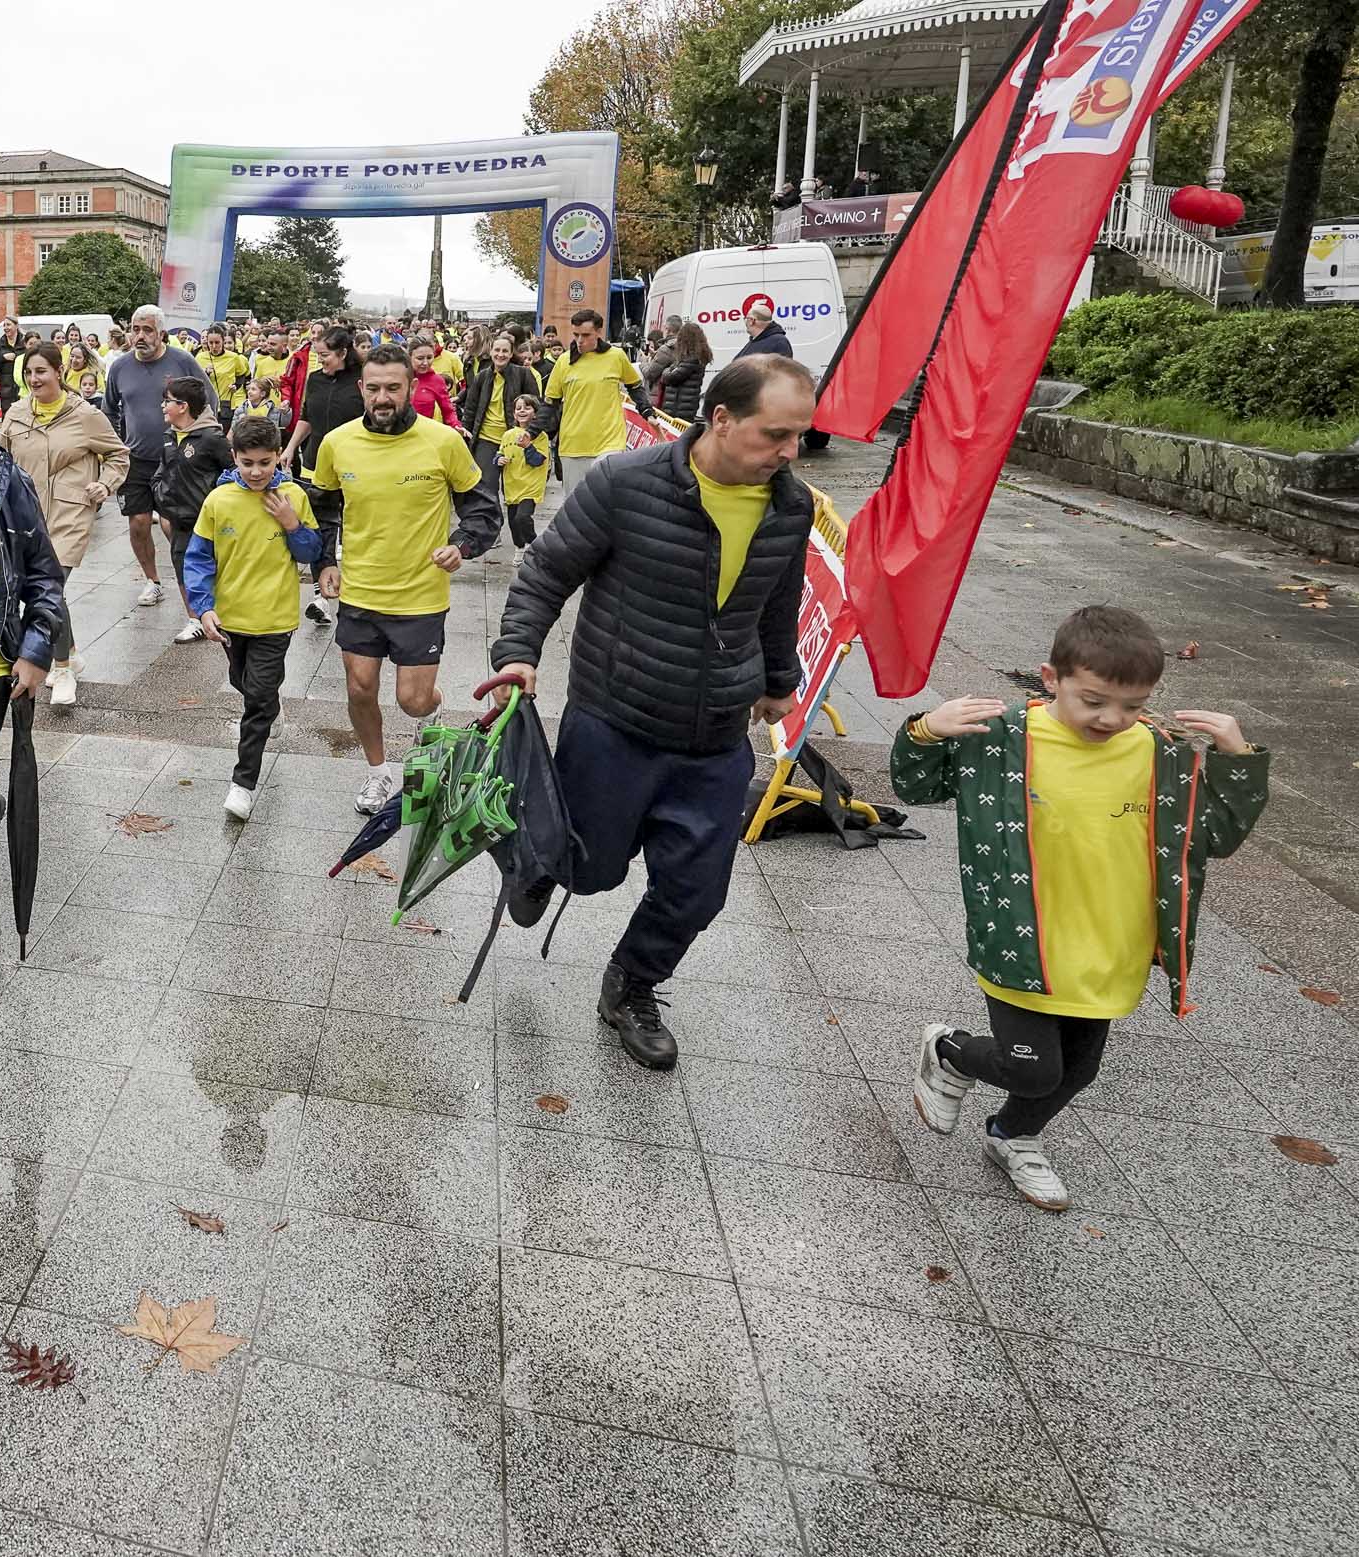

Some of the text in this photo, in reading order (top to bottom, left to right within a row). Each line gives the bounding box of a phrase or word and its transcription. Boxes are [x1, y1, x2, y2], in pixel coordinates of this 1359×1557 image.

[231, 154, 547, 177] DEPORTE PONTEVEDRA
[558, 210, 601, 226] DEPORTE
[814, 210, 866, 226] CAMINO
[555, 236, 604, 260] PONTEVEDRA
[394, 474, 432, 485] galicia
